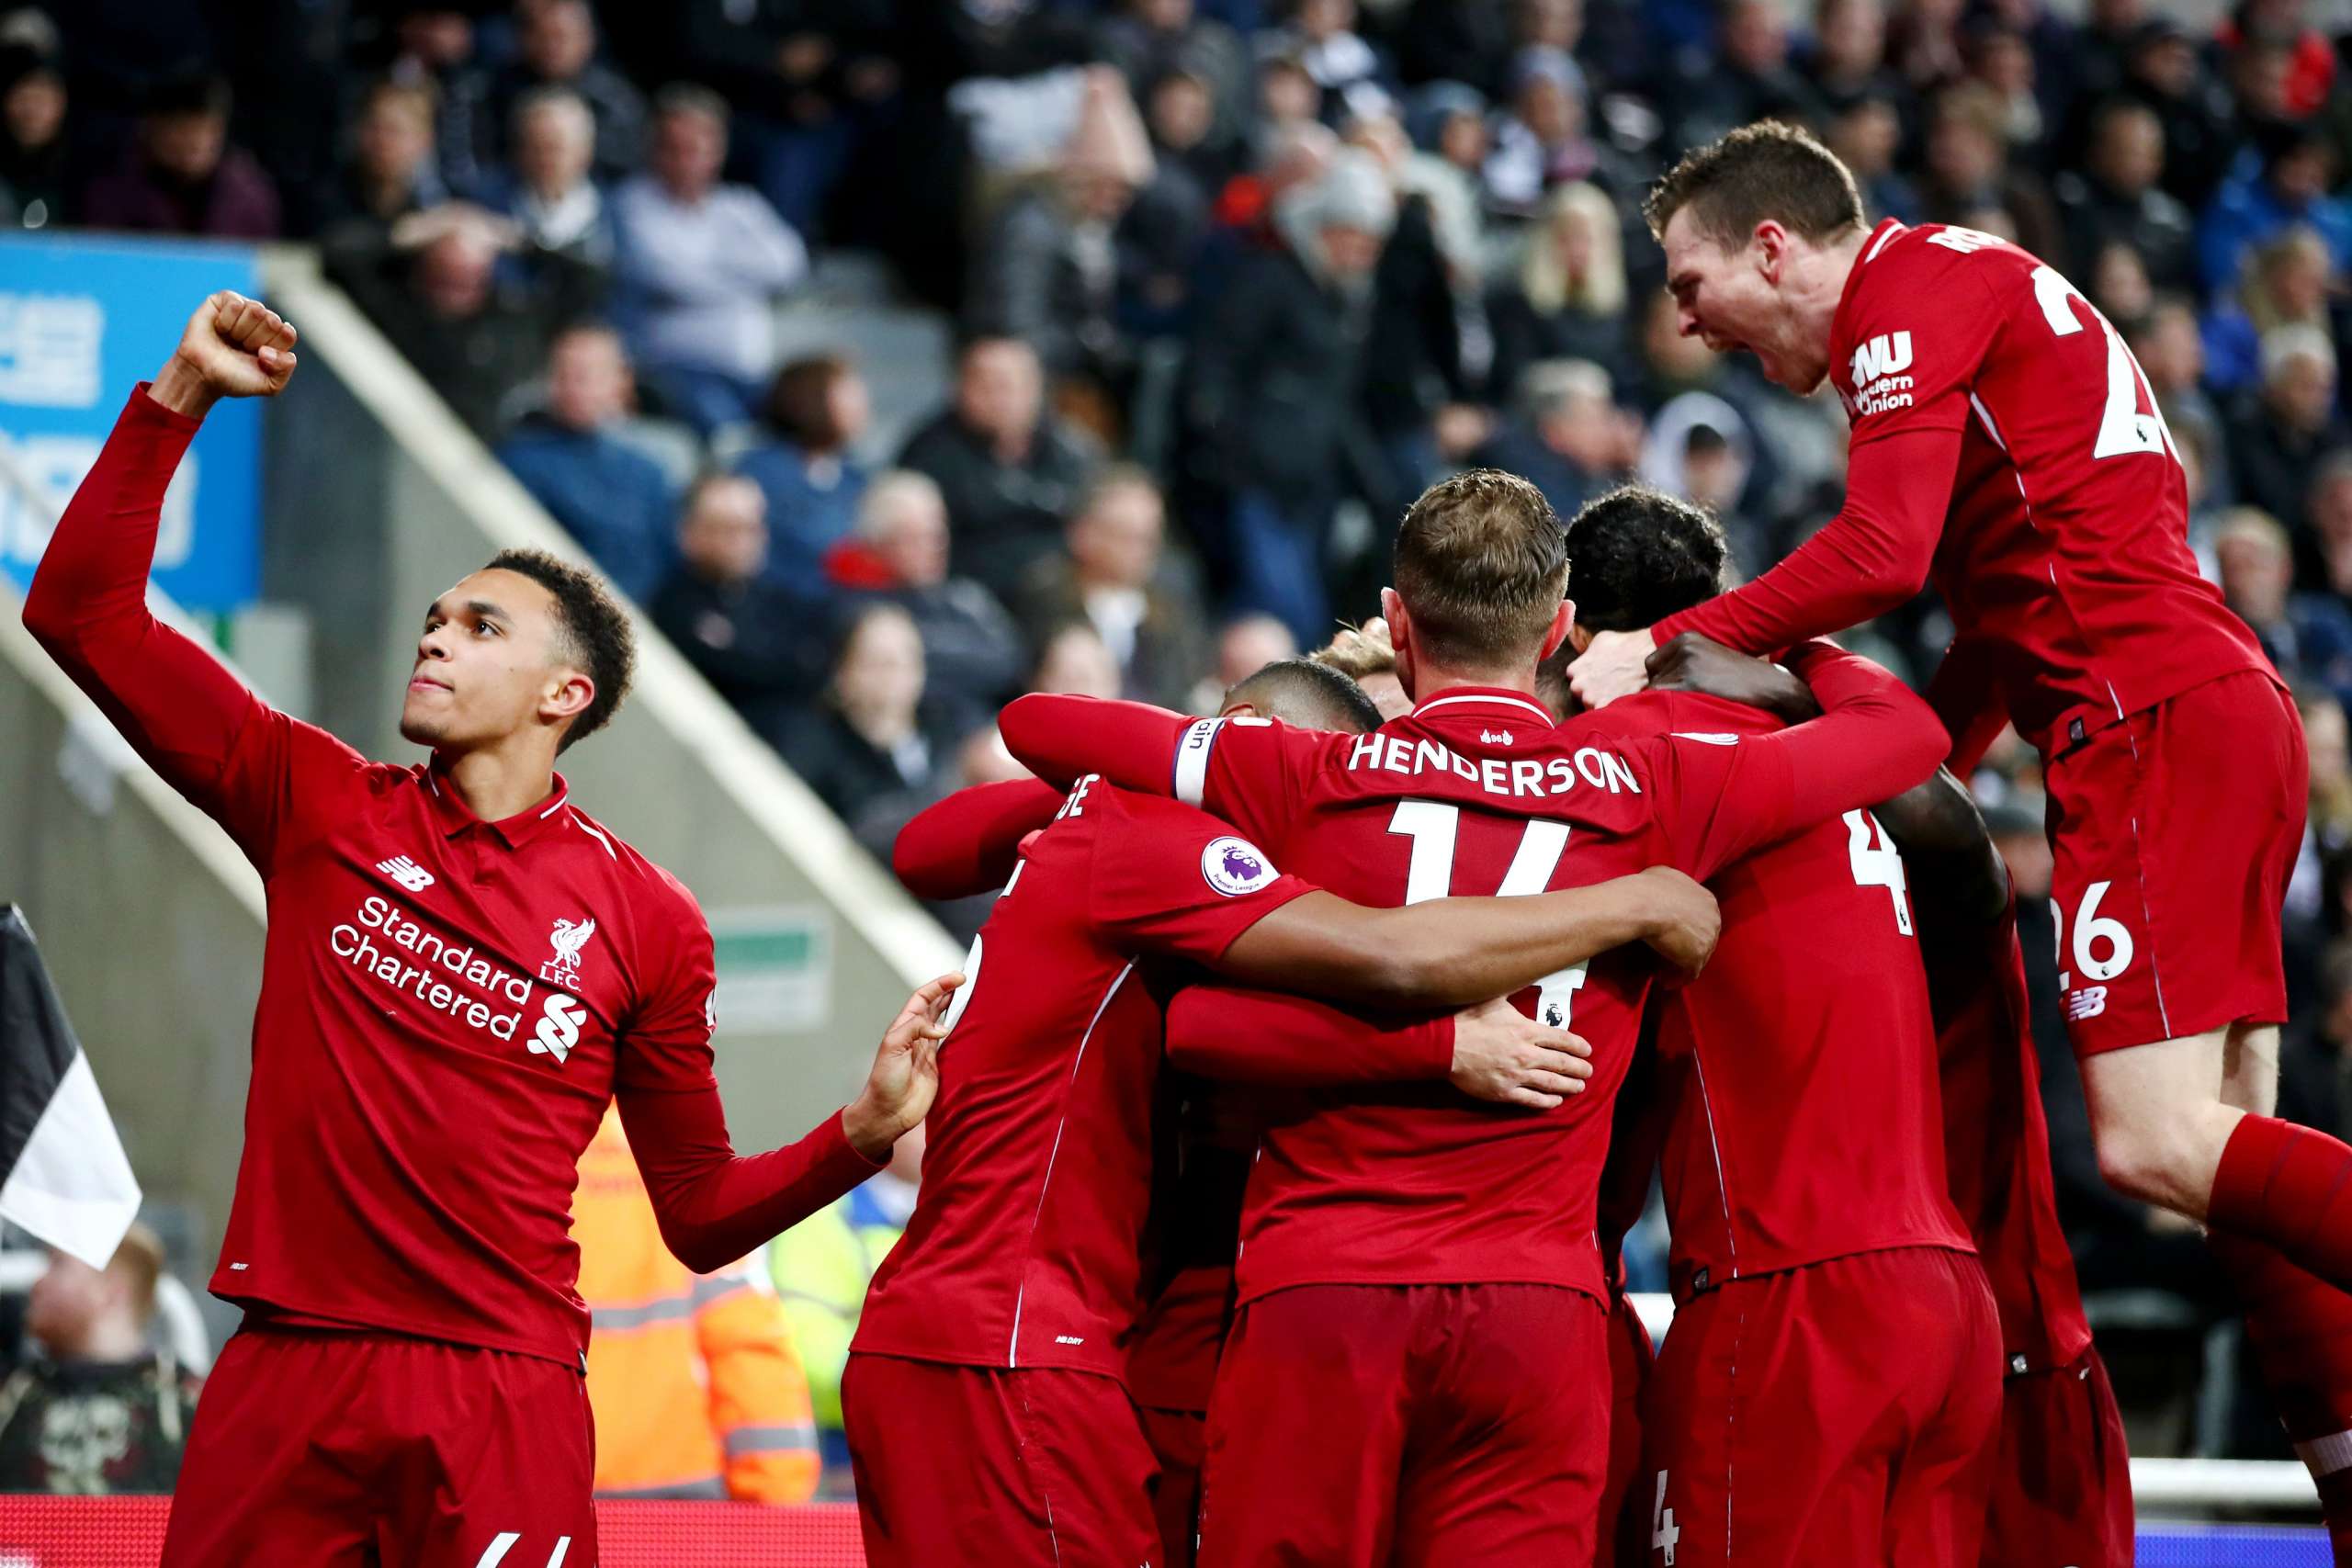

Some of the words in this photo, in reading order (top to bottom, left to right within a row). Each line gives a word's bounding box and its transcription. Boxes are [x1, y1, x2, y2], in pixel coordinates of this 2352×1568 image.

[1860, 392, 1914, 416] Union
[1348, 734, 1642, 797] HENDERSON
[1841, 807, 1914, 937] 4
[331, 924, 522, 1042] Chartered
[357, 897, 534, 1006] Standard
[1651, 1469, 1680, 1567] 4
